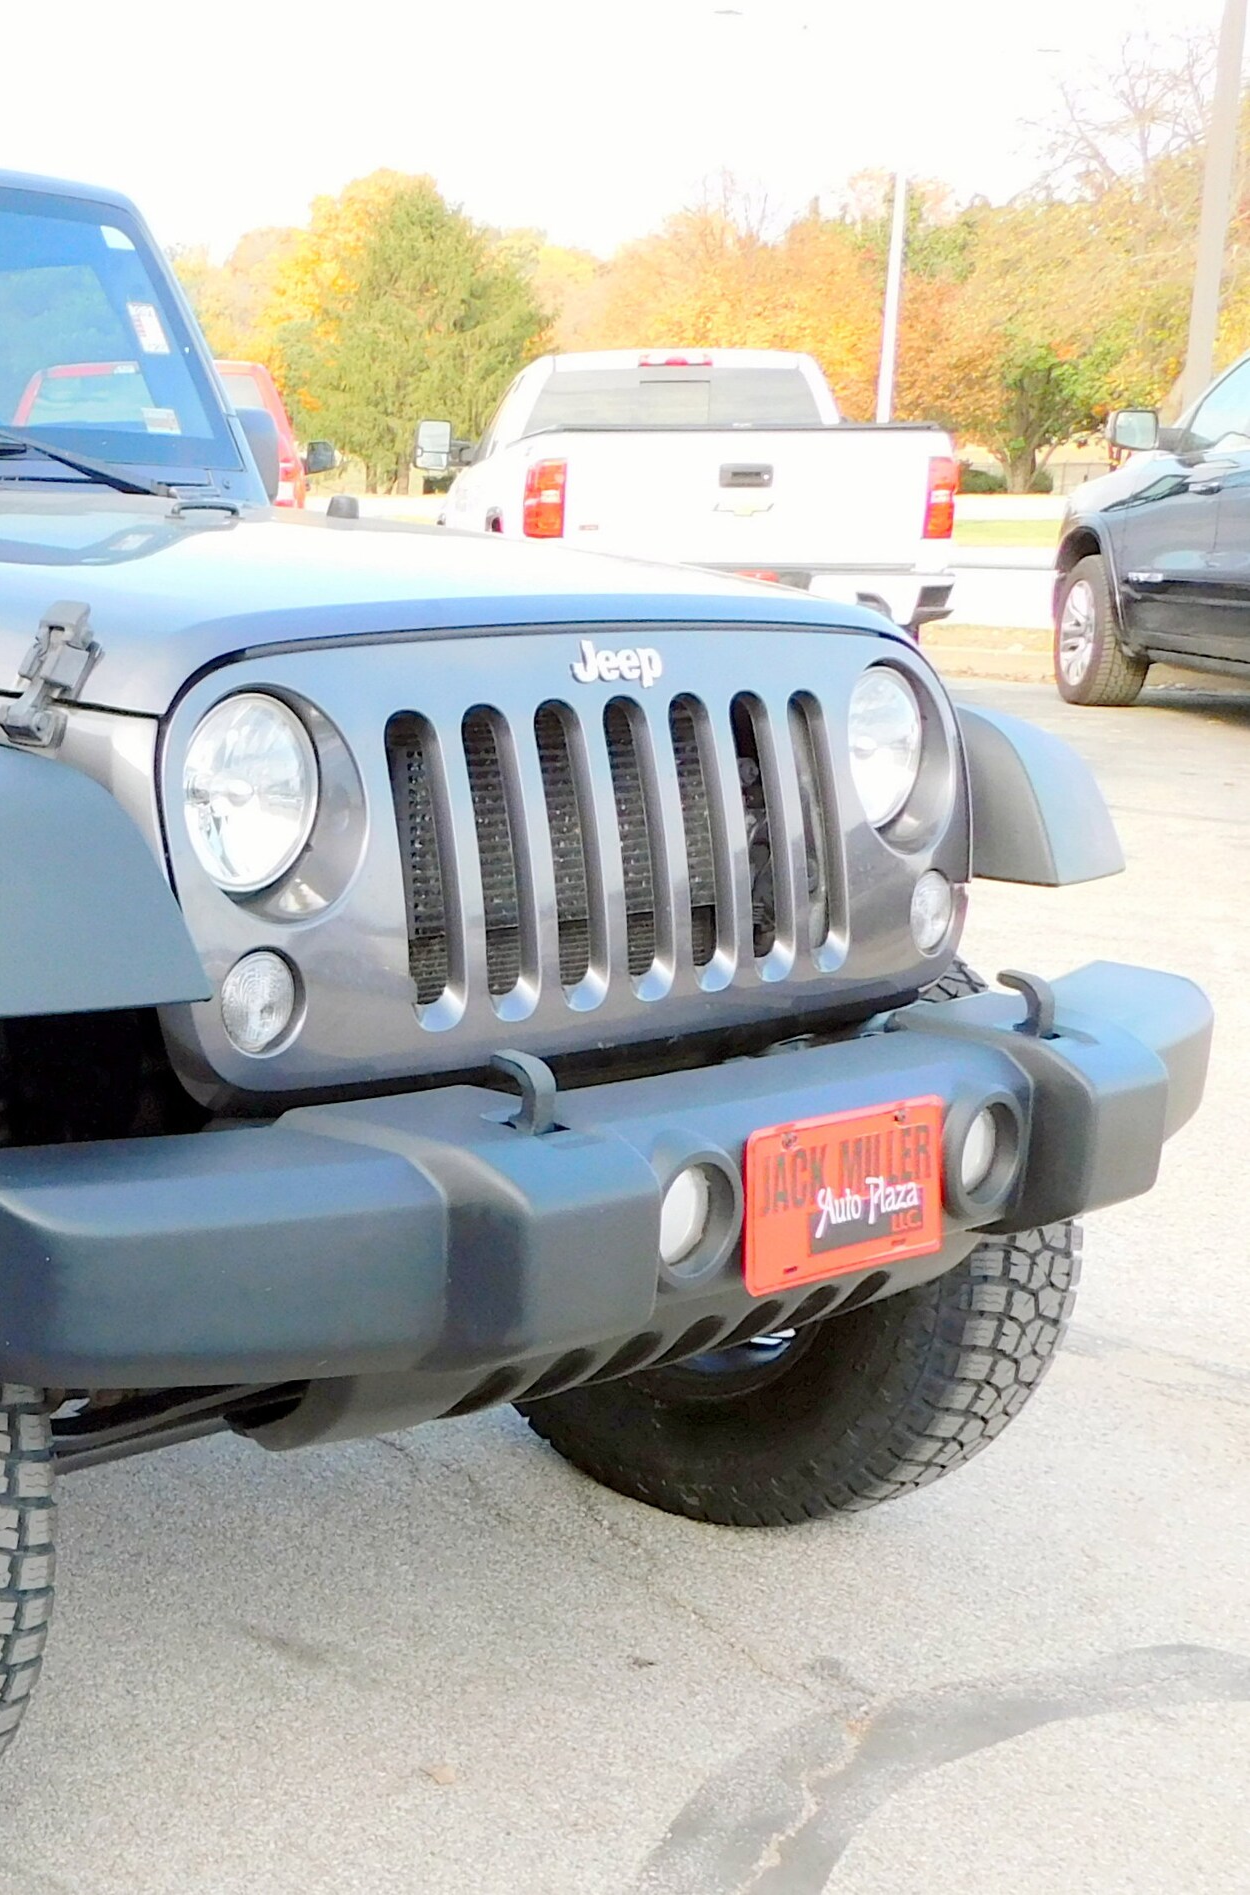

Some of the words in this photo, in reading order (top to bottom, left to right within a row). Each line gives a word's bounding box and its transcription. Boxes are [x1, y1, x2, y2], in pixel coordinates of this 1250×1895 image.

[570, 639, 662, 688] Jeep
[759, 1144, 828, 1217] JACK
[837, 1124, 932, 1198] MILLER
[815, 1186, 862, 1239] Auto
[865, 1175, 919, 1225] Plaza
